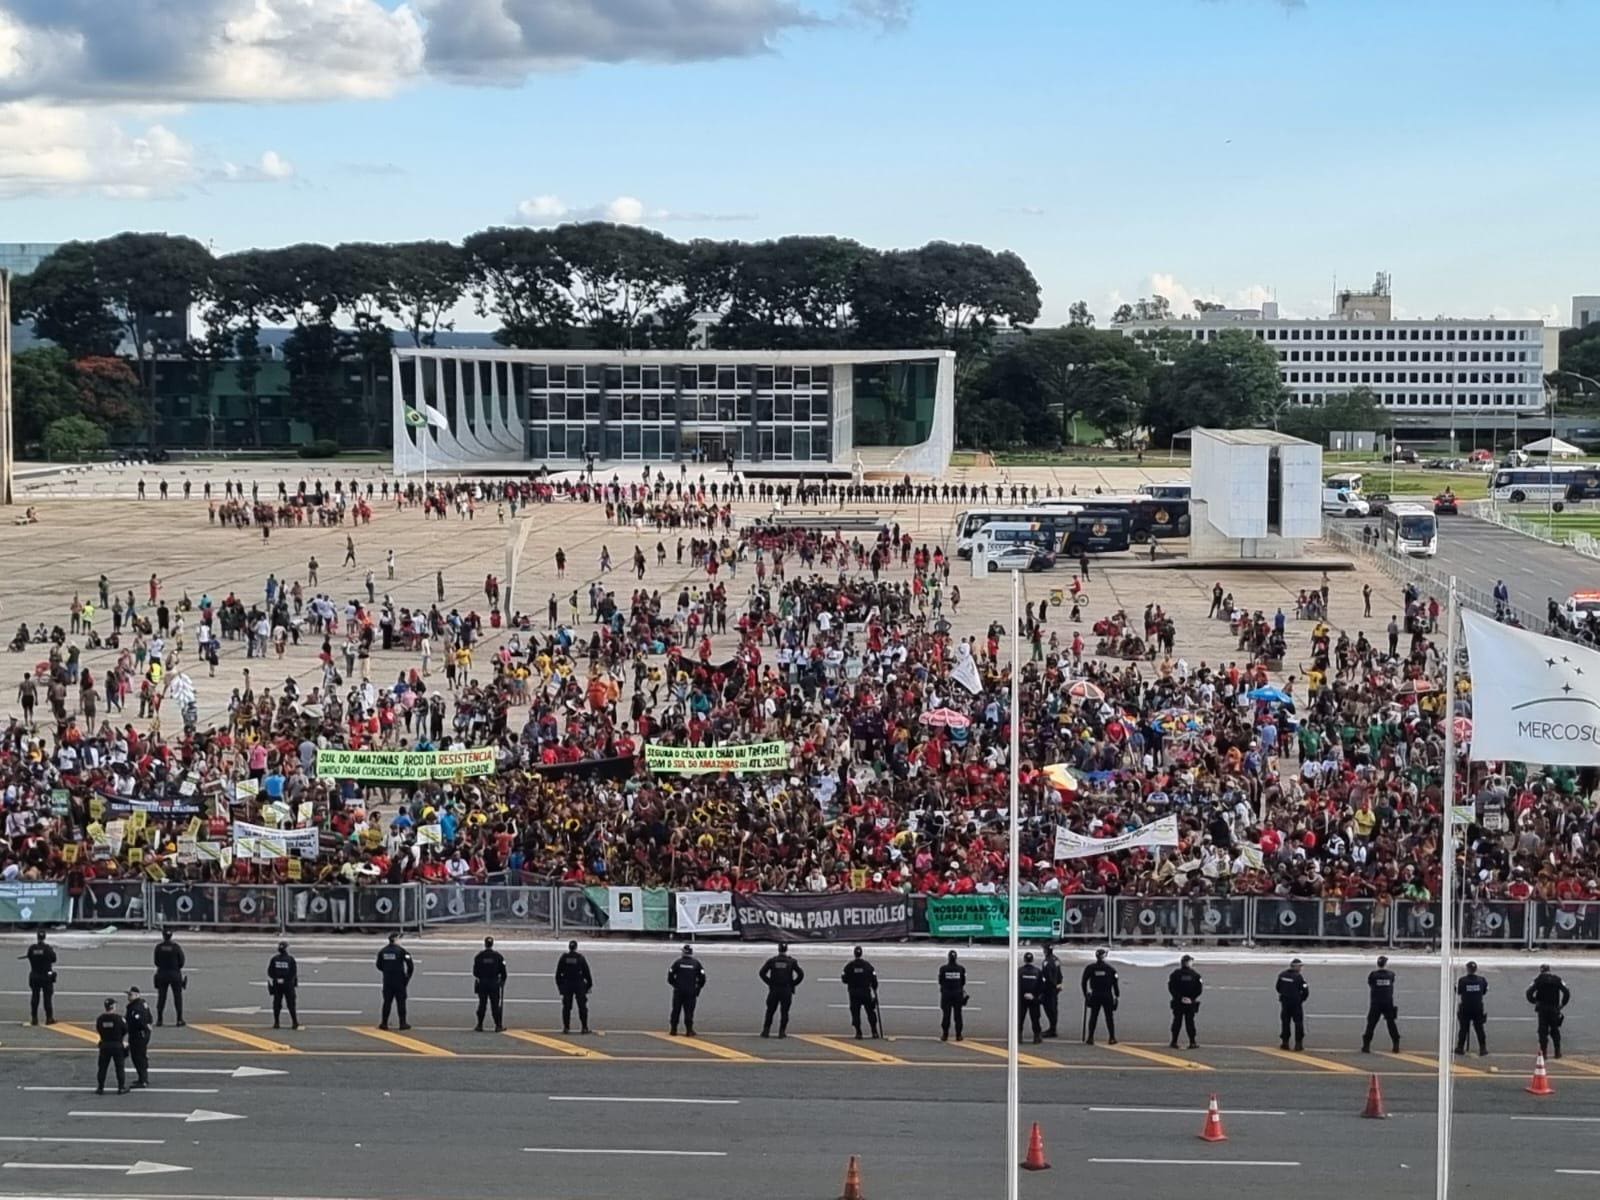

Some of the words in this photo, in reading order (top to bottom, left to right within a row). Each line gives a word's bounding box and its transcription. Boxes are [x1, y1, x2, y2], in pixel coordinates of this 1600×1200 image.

[748, 744, 780, 756] TREMER
[319, 753, 336, 763] SUL
[339, 753, 351, 764] DO
[353, 754, 399, 766] AMAZONAS
[405, 755, 424, 765] ARCO
[426, 755, 437, 765] DA
[647, 758, 665, 769] COM
[673, 760, 686, 769] SUL
[688, 760, 698, 768] DO
[749, 758, 762, 768] ATL
[319, 765, 340, 775] UNIDO
[342, 766, 361, 776] PARA
[417, 767, 428, 777] DA
[739, 907, 766, 925] SEM
[765, 910, 805, 929] CLIMA
[807, 909, 841, 929] PARA
[843, 904, 905, 926] PETRÓLEO
